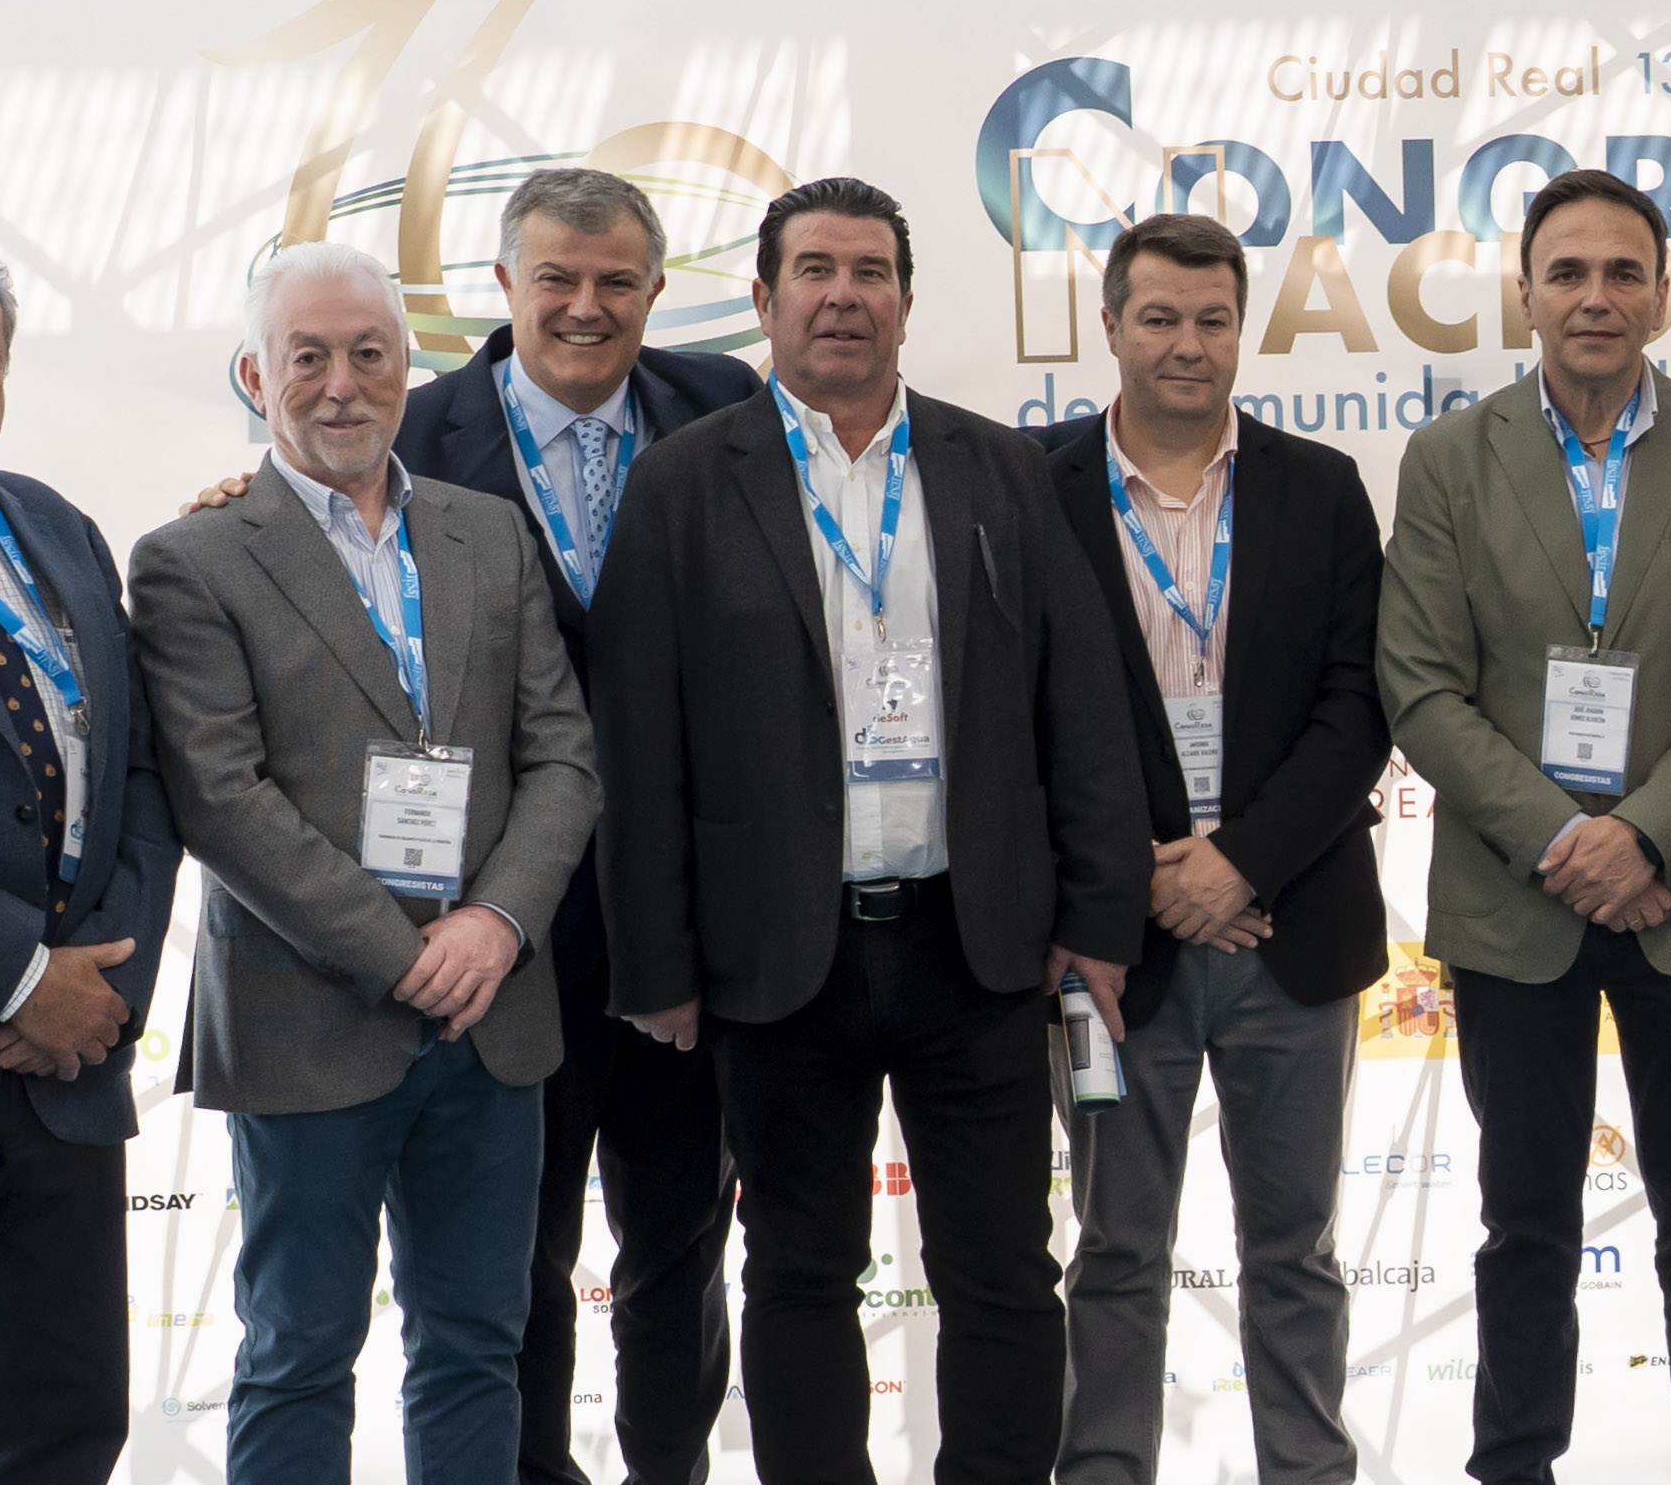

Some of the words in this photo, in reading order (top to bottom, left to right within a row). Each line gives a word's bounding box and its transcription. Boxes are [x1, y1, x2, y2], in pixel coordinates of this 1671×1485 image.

[1268, 48, 1460, 103] Ciudad
[1487, 46, 1600, 97] Real
[1554, 771, 1611, 785] CONGRESISTAS
[187, 1401, 228, 1412] Solven
